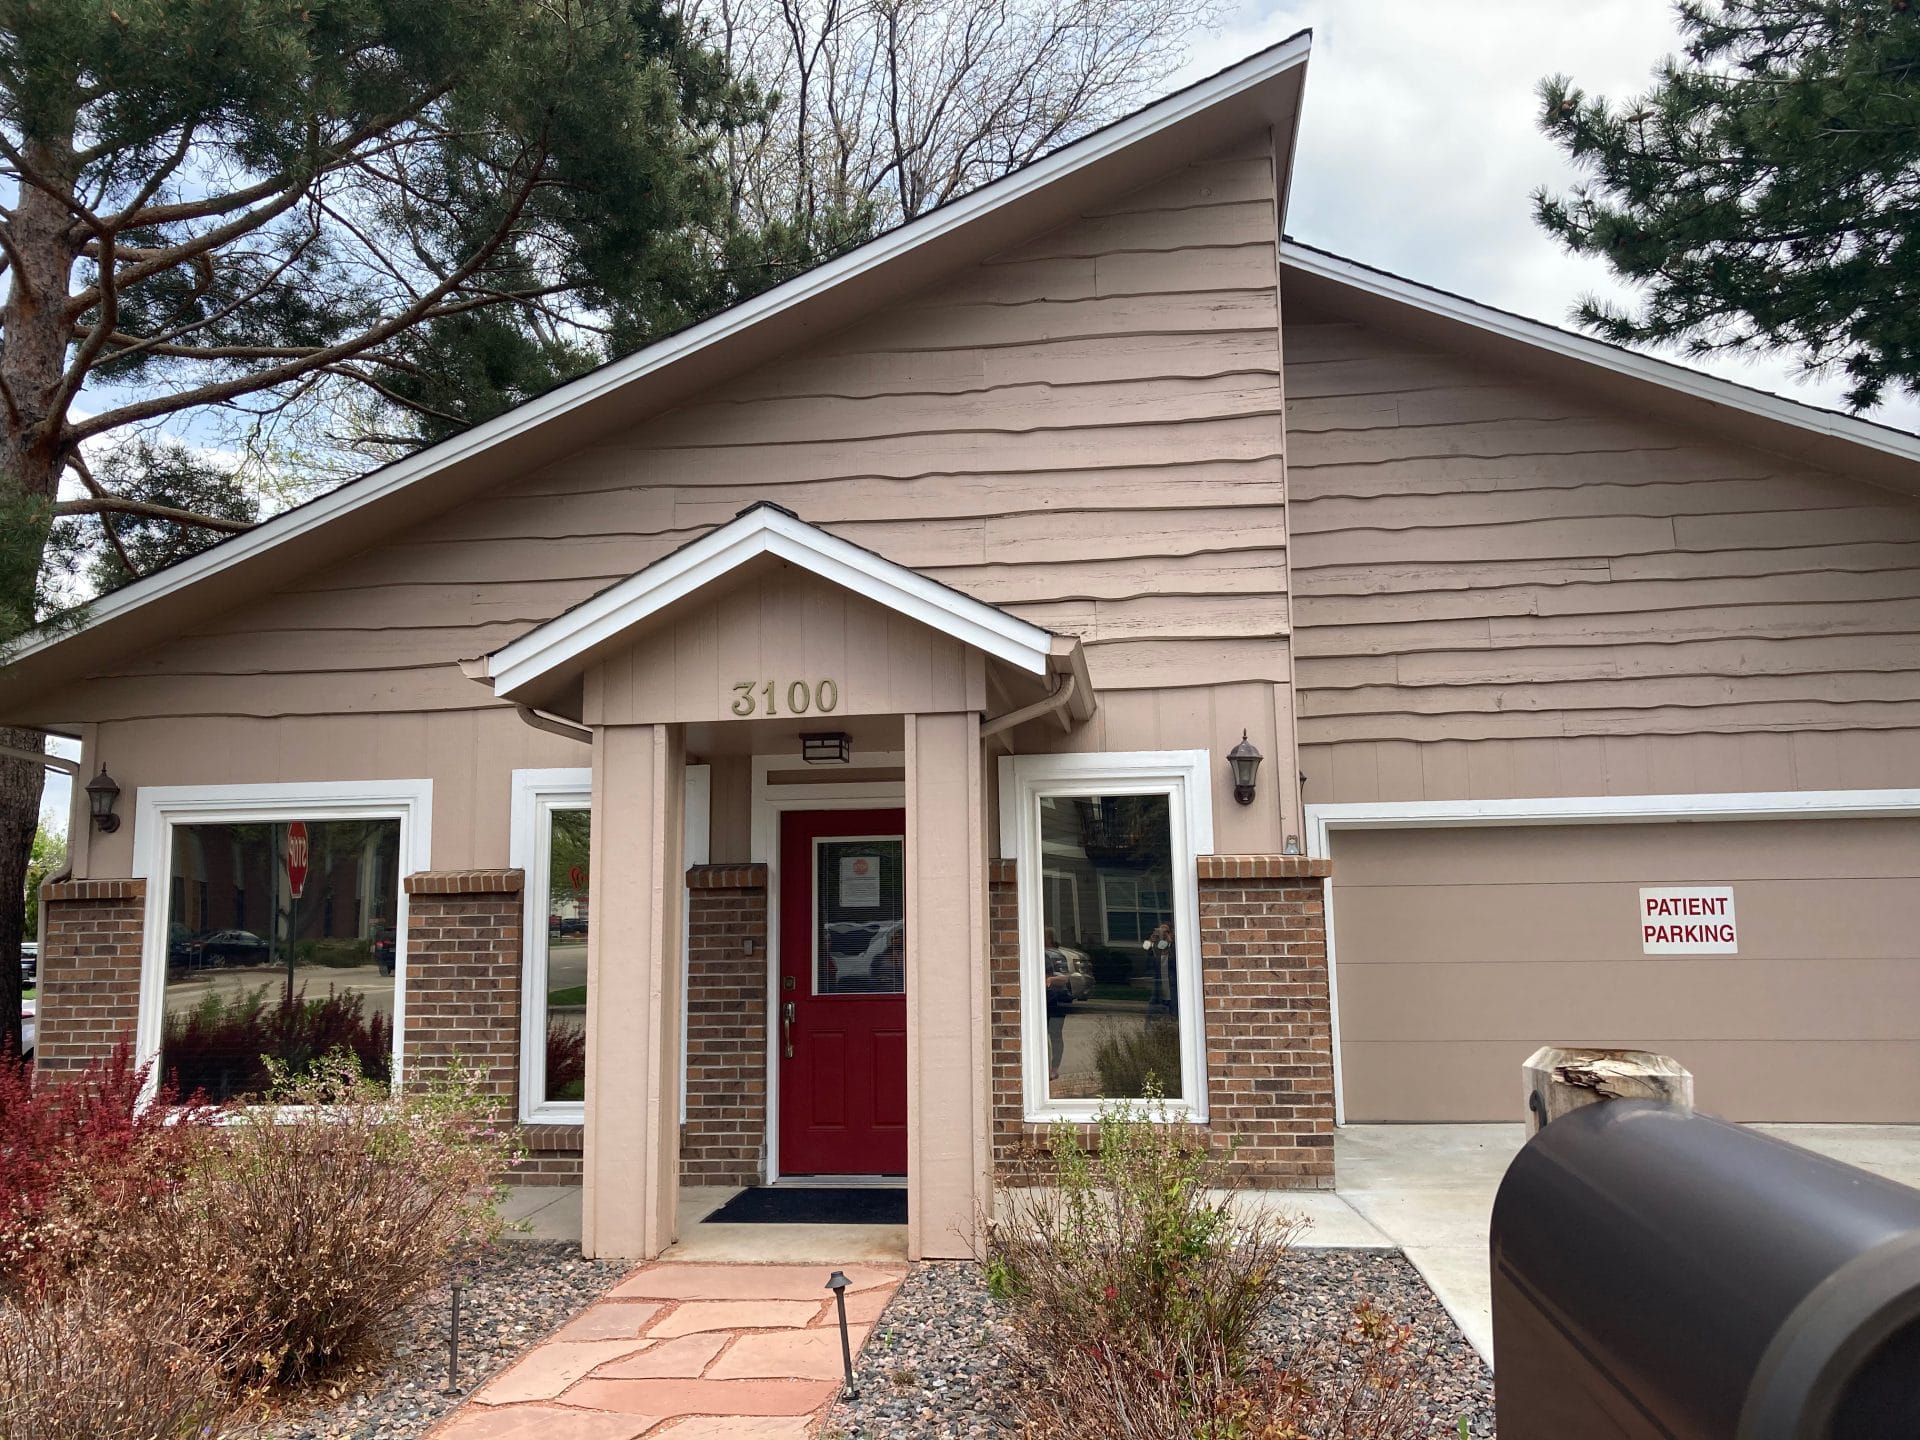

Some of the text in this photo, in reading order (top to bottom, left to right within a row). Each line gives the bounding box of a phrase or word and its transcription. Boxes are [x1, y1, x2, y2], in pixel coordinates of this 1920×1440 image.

[731, 680, 838, 716] 3100
[1646, 897, 1728, 916] PATIENT
[1644, 924, 1735, 943] PARKING
